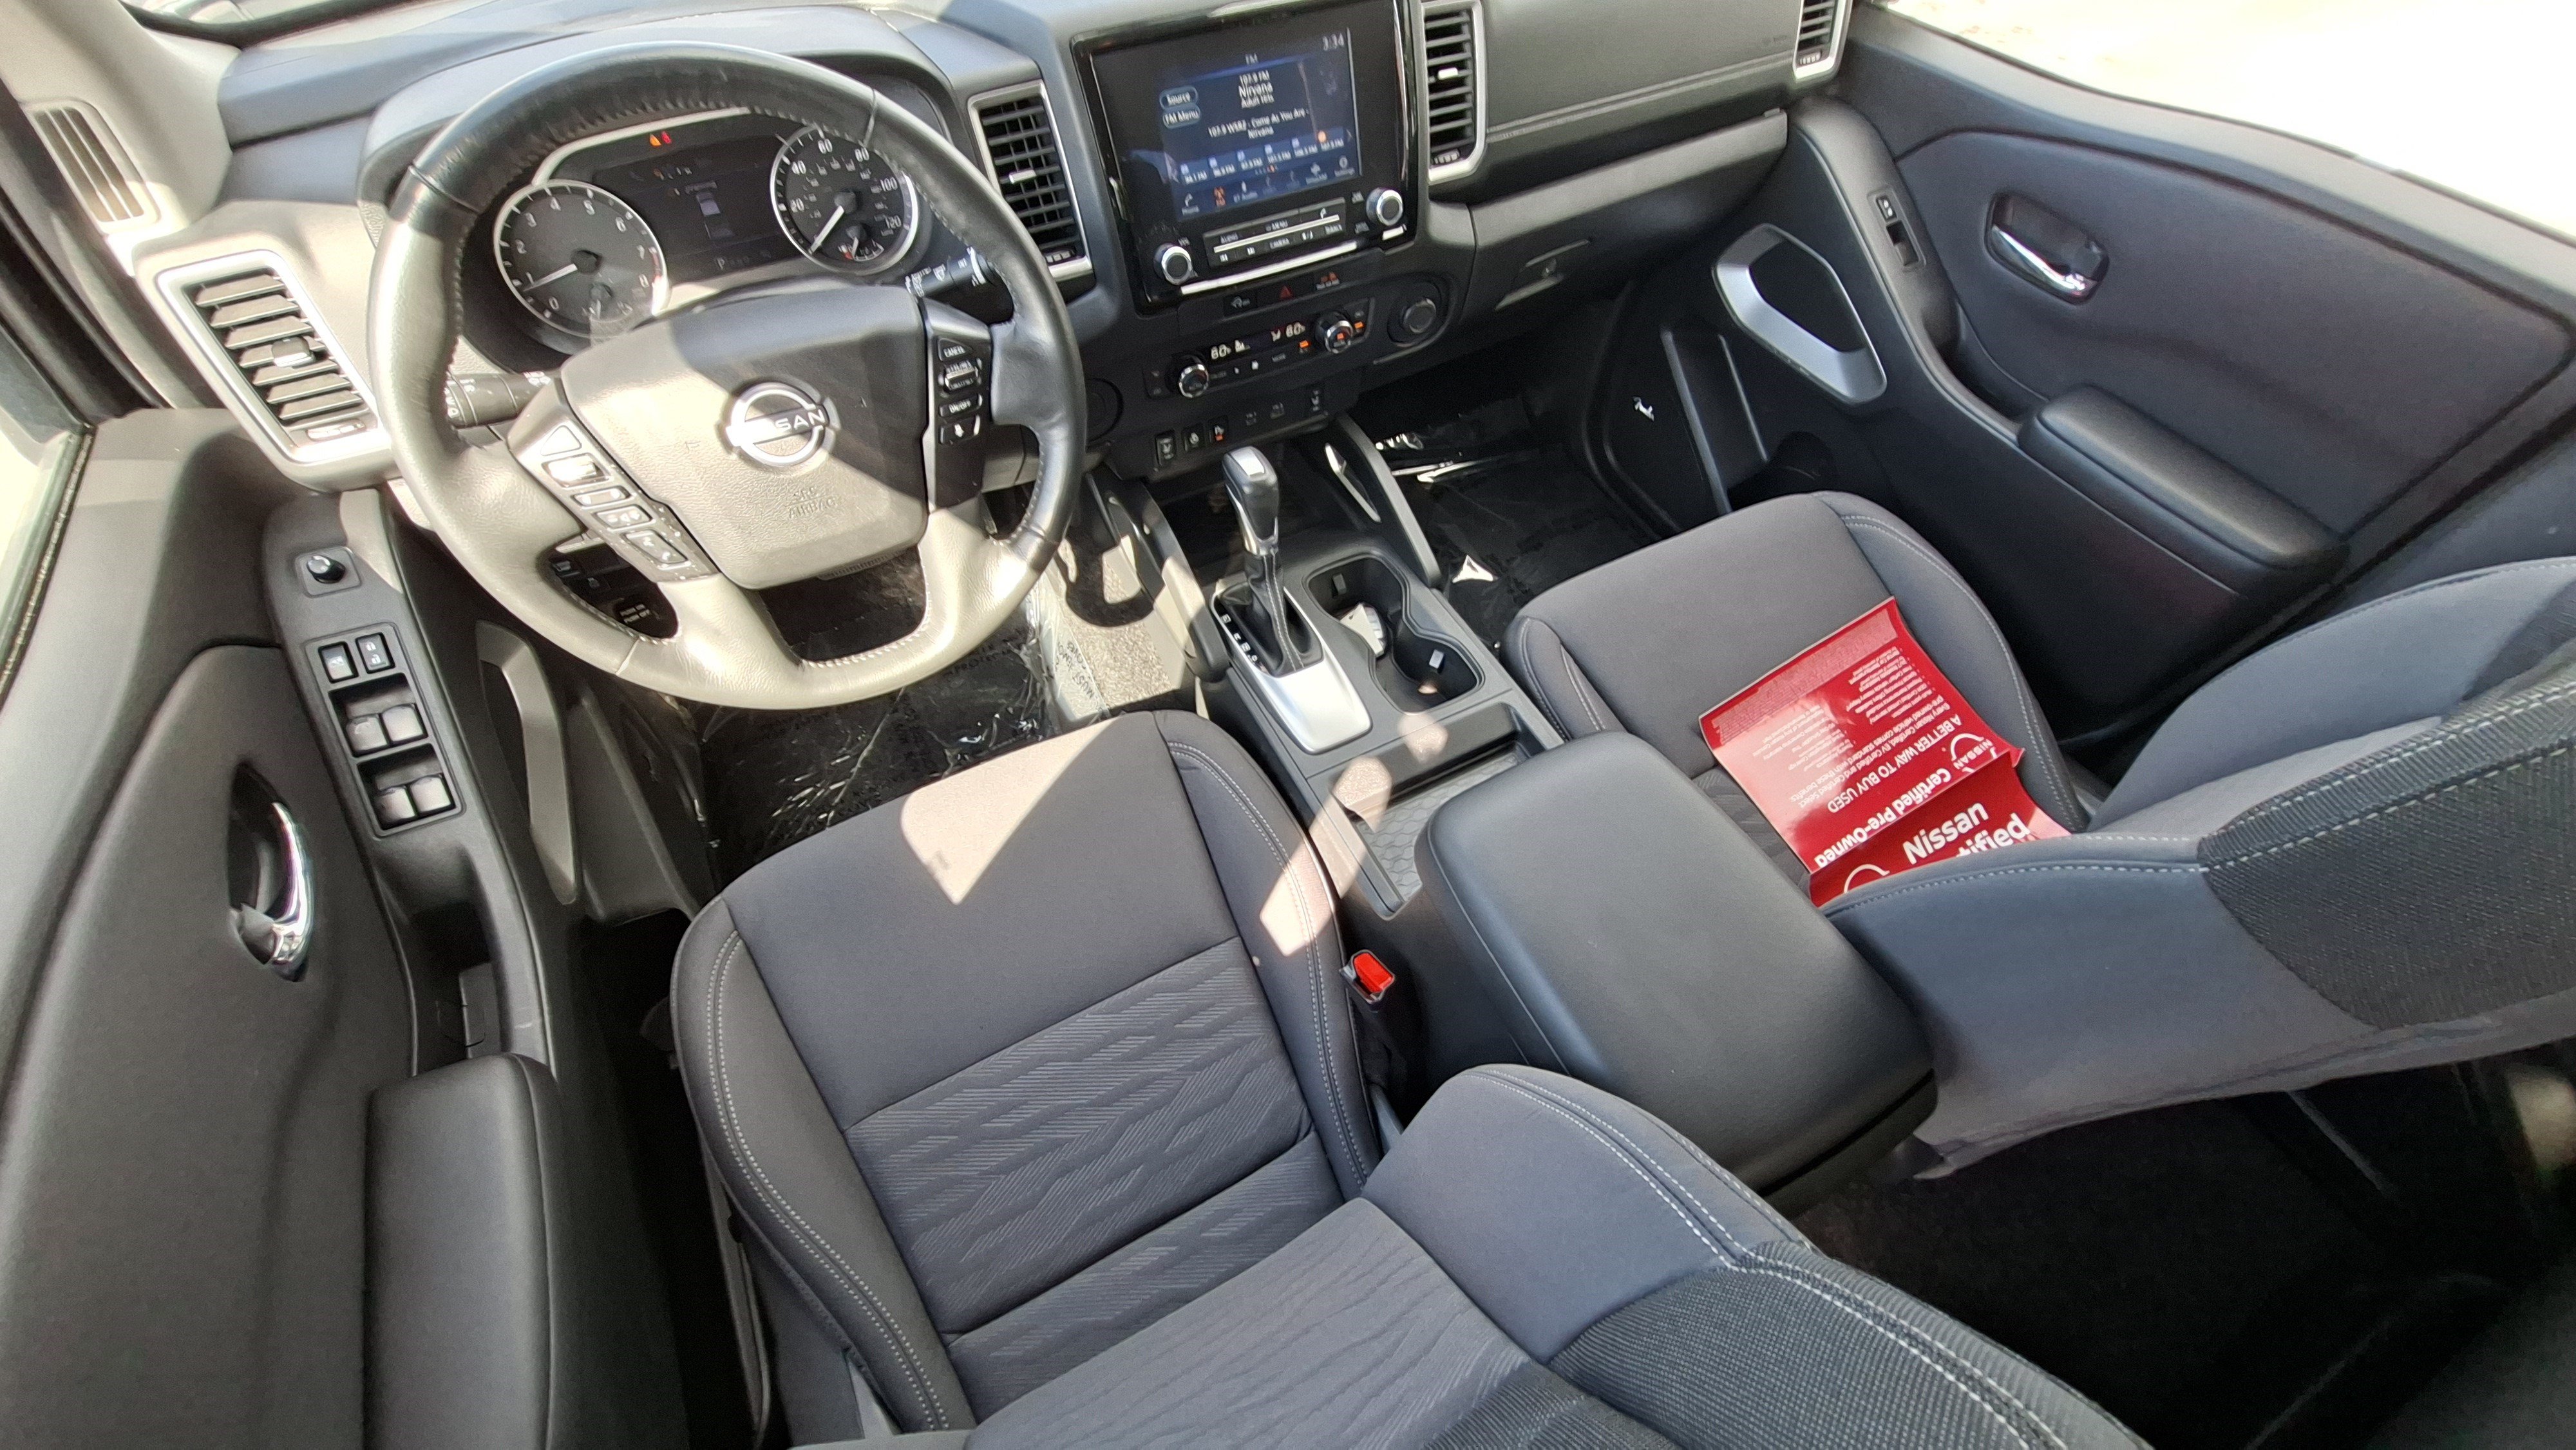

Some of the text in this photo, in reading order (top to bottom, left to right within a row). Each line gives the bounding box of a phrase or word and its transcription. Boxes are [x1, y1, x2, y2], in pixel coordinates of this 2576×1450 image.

[1238, 82, 1274, 97] Nirvana
[1247, 126, 1274, 140] Nirvana
[817, 138, 833, 155] 60
[854, 147, 869, 162] 80
[880, 176, 898, 192] 100
[583, 200, 595, 216] 5
[549, 296, 560, 310] 0
[1911, 693, 1944, 720] pre-owned
[1930, 700, 1950, 719] Every
[1891, 715, 1914, 734] vehicle
[1913, 713, 1933, 731] Nissan
[1873, 729, 1894, 747] comes
[1888, 724, 1916, 748] Certified,
[1846, 742, 1875, 765] standard
[1880, 742, 1891, 753] EV
[1826, 713, 1962, 814] A BETTER WAY TO BUY USED
[1832, 760, 1848, 774] with
[1855, 748, 1882, 770] Certified
[1815, 769, 1835, 786] these
[1843, 765, 1857, 778] and
[1788, 780, 1818, 804] benefits:
[1817, 773, 1846, 795] Certified
[1797, 790, 1819, 809] Select
[1813, 737, 1993, 869] NISSAN Certified Pre-Owned
[1899, 797, 1991, 865] Nissan
[1956, 813, 2031, 858] tified
